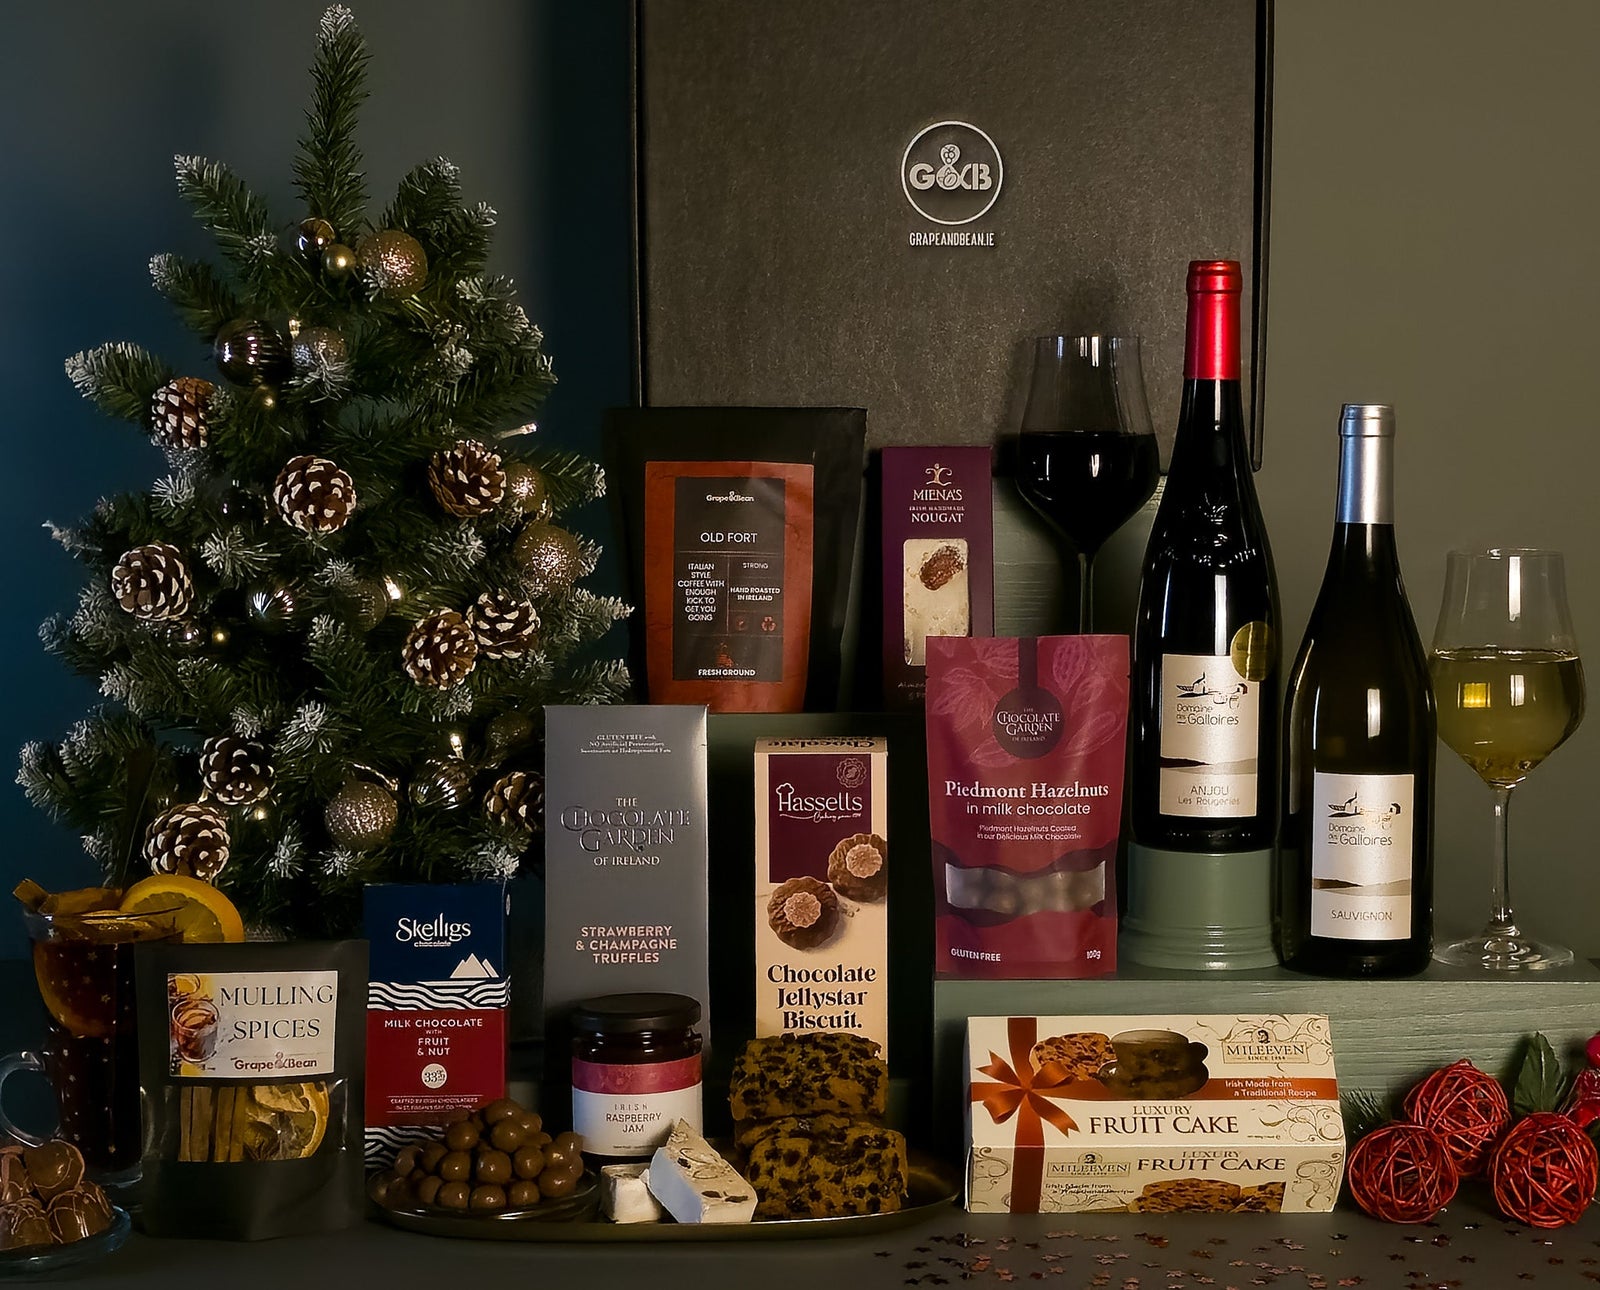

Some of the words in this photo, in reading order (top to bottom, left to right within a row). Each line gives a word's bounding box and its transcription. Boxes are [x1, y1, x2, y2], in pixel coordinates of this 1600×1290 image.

[909, 232, 995, 246] GRAPEANDBEAN.IE
[913, 489, 963, 501] MIENA'S
[911, 513, 964, 523] NOUGAT
[700, 532, 724, 543] OLD
[727, 532, 758, 543] FORT
[691, 571, 711, 579] STYLE
[685, 588, 716, 596] ENOUGH
[685, 605, 699, 613] GET
[700, 605, 716, 613] YOU
[688, 614, 713, 622] GOING
[698, 668, 722, 676] FRESH
[1176, 703, 1213, 713] Domaine
[997, 711, 1060, 725] CHOCOLATE
[1187, 713, 1239, 725] Galloires
[1006, 722, 1053, 736] GARDEN
[945, 780, 1026, 798] Piedmont
[1030, 781, 1109, 798] Hazelnuts
[1190, 786, 1229, 795] ANJOU
[616, 797, 638, 807] THE
[777, 788, 863, 811] Hassells
[1178, 797, 1192, 805] Les
[966, 802, 978, 814] in
[982, 802, 1012, 815] milk
[1016, 802, 1091, 816] chocolate
[560, 805, 690, 831] CHOCOLATE
[1328, 823, 1365, 833] Domaine
[579, 828, 675, 853] GARDEN
[1339, 833, 1393, 846] Galloires
[594, 856, 608, 866] OF
[612, 856, 660, 866] IRELAND
[1331, 909, 1393, 921] SAUVIGNON
[395, 912, 472, 942] Skelligs
[581, 925, 673, 937] STRAWBERRY
[413, 940, 452, 948] chocolate
[575, 940, 585, 951] &
[589, 939, 678, 950] CHAMPAGNE
[593, 952, 660, 963] TRUFFLES
[951, 948, 979, 960] GLUTEN
[980, 953, 1001, 962] FREE
[1086, 950, 1101, 960] 100g
[767, 964, 877, 983] Chocolate
[220, 985, 334, 1006] MULLING
[776, 987, 868, 1009] Jellystar
[384, 1019, 411, 1028] MILK
[415, 1018, 483, 1028] CHOCOLATE
[783, 1010, 863, 1029] Biscuit.
[232, 1018, 321, 1040] SPICES
[418, 1037, 449, 1046] FRUIT
[417, 1048, 424, 1056] &
[428, 1047, 451, 1055] NUT
[1227, 1044, 1305, 1056] MILEEVEN
[234, 1052, 317, 1072] Grape&Bean
[1225, 1080, 1243, 1088] Irish
[1245, 1080, 1270, 1088] Made
[1241, 1088, 1286, 1097] Traditional
[1288, 1089, 1318, 1098] Recipe
[614, 1103, 648, 1111] IRISH
[1133, 1105, 1192, 1115] LUXURY
[605, 1113, 662, 1123] RASPBERRY
[622, 1124, 645, 1133] JAM
[1089, 1116, 1165, 1134] FRUIT
[1172, 1116, 1239, 1134] CAKE
[1051, 1164, 1128, 1172] MILEEVEN
[1137, 1158, 1215, 1171] FRUIT
[1220, 1158, 1286, 1171] CAKE
